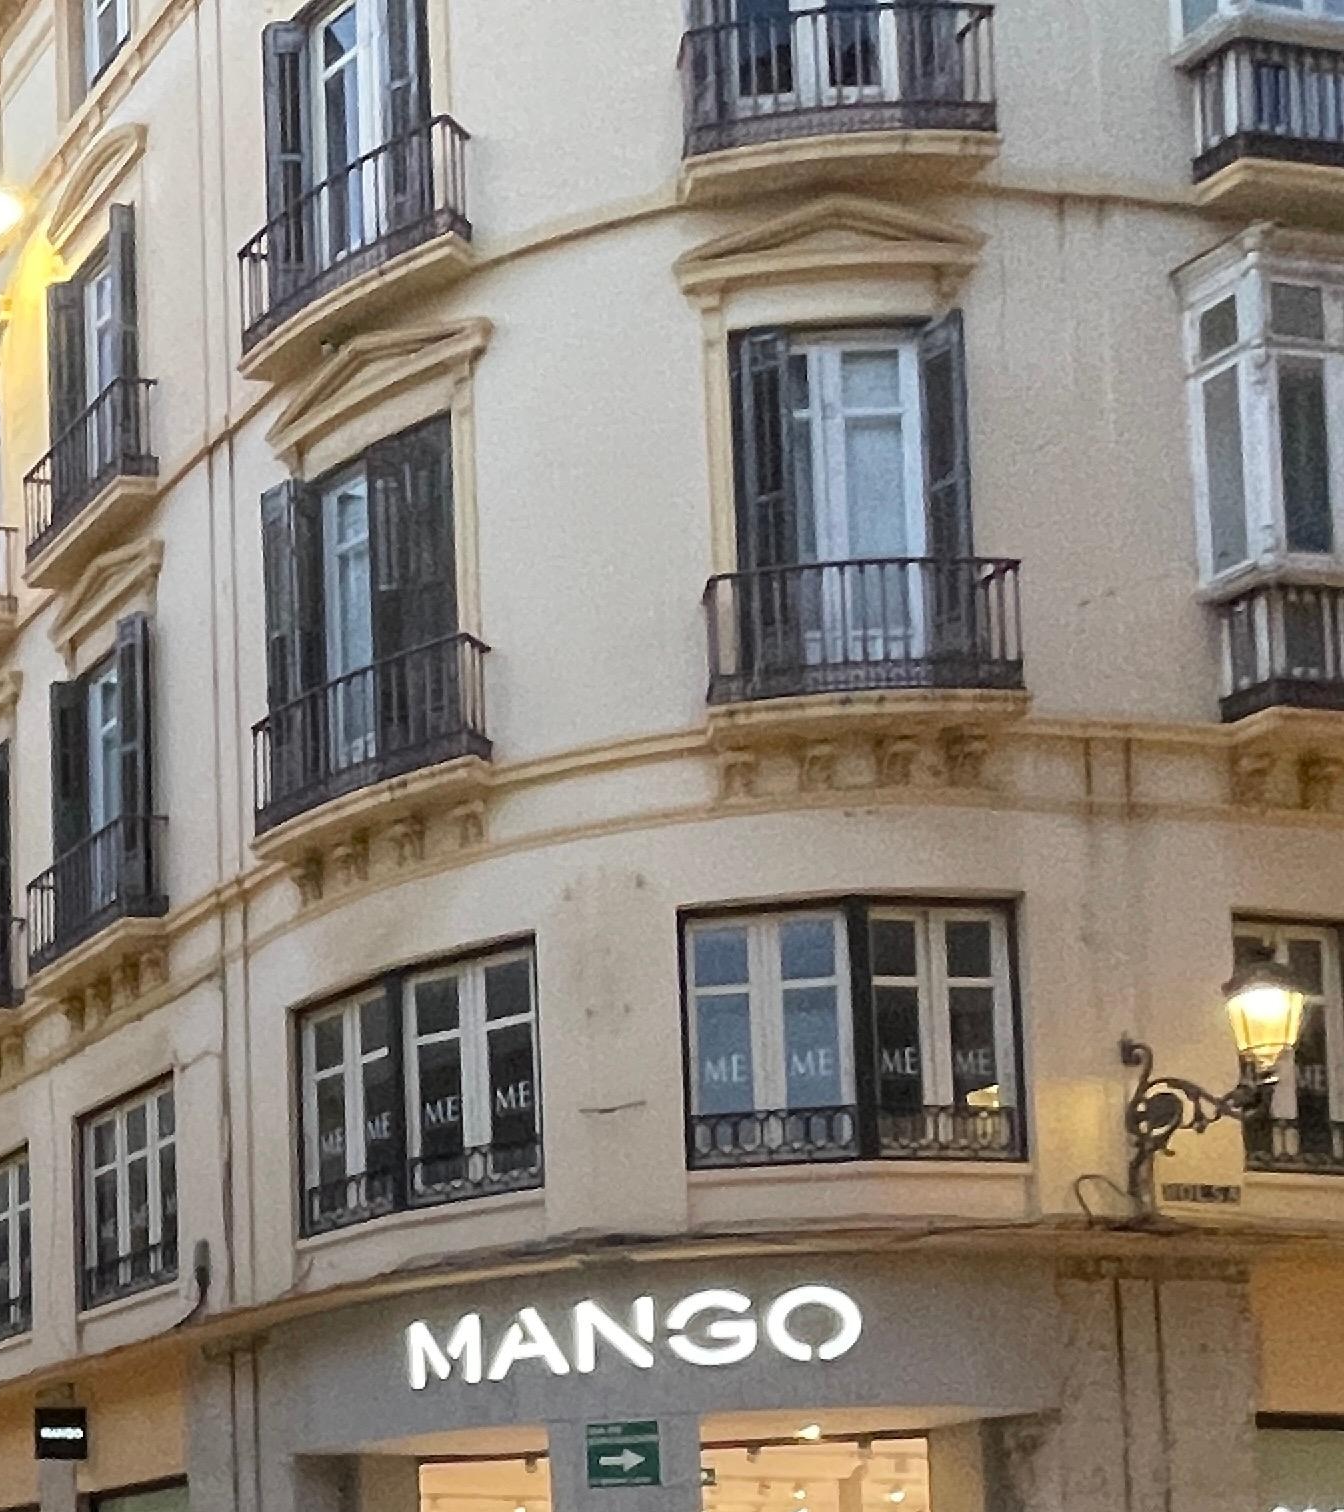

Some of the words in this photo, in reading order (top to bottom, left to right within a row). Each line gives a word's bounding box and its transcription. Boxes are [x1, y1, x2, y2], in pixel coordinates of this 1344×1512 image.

[703, 1053, 748, 1083] ME
[791, 1047, 834, 1077] ME
[881, 1046, 919, 1074] ME
[424, 1096, 461, 1126] ME
[496, 1080, 530, 1117] ME
[367, 1111, 393, 1140] ME
[409, 1285, 862, 1390] MANGO
